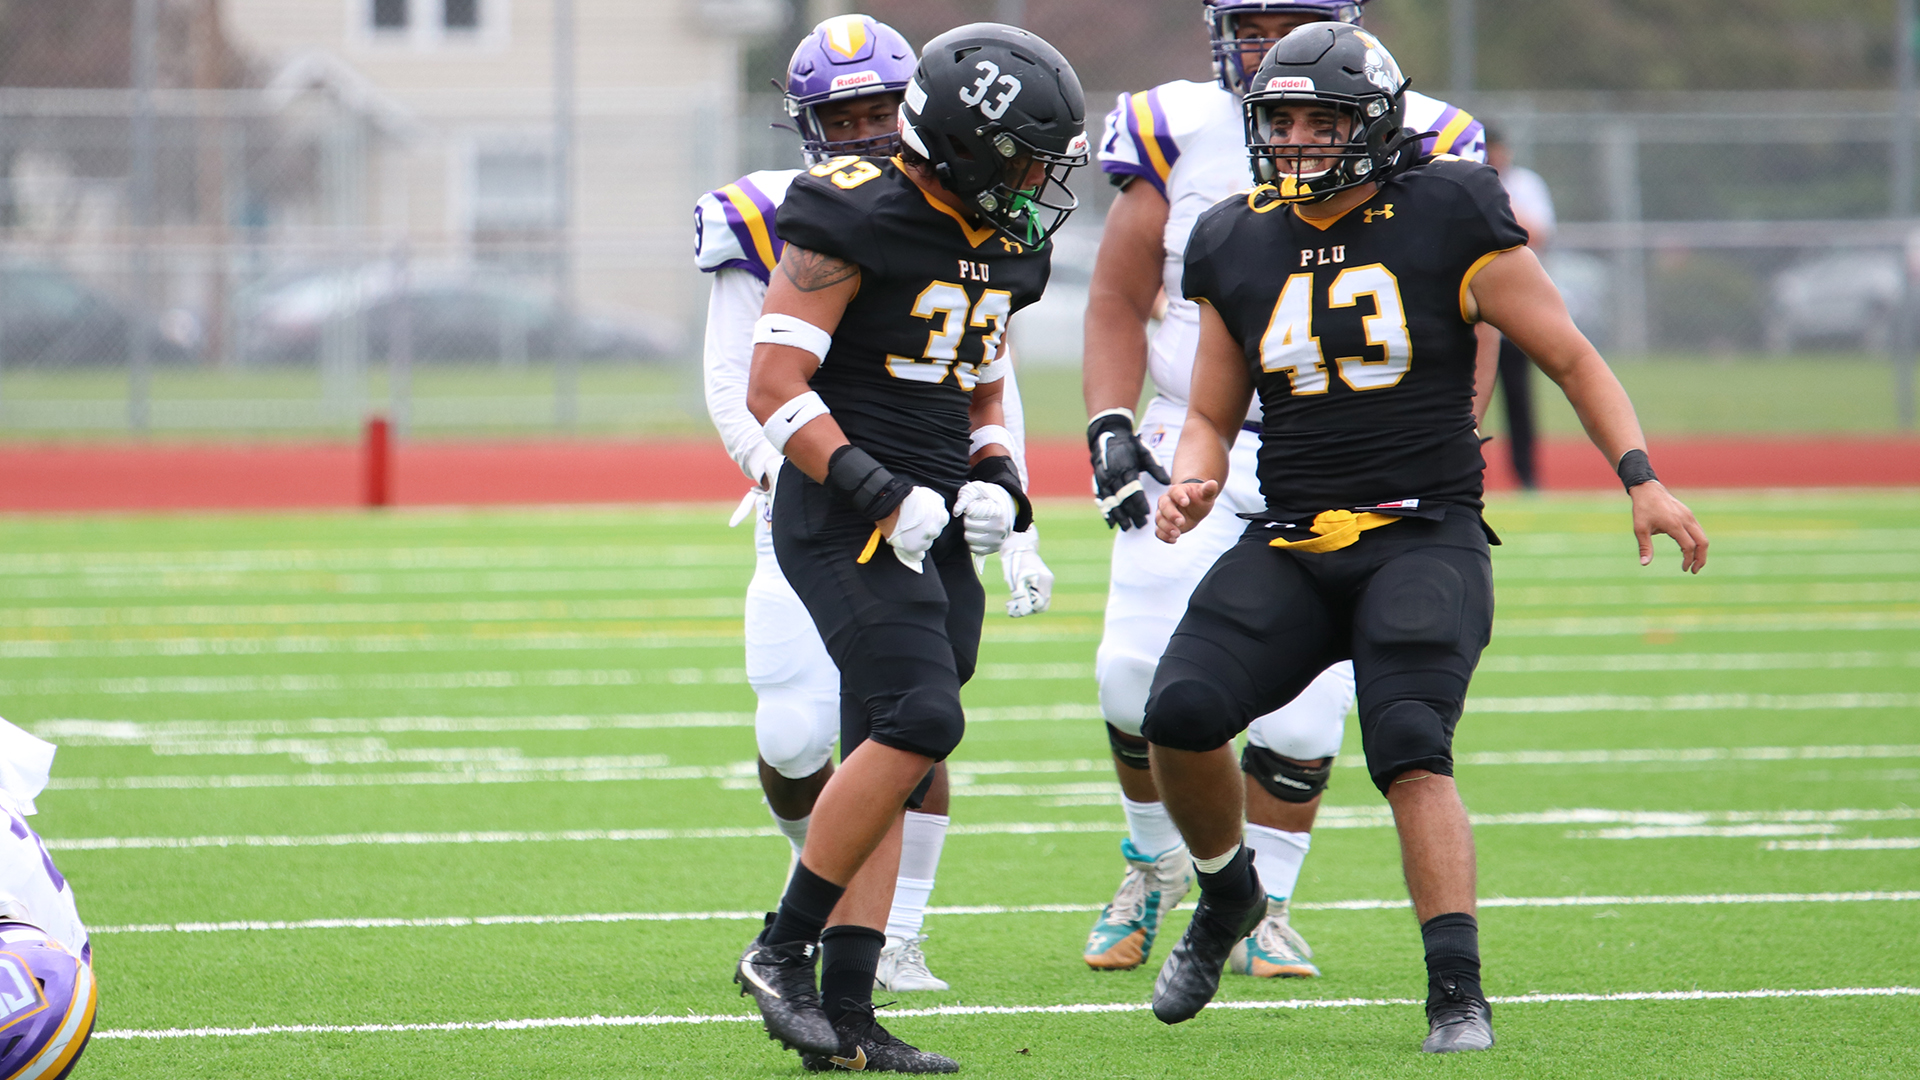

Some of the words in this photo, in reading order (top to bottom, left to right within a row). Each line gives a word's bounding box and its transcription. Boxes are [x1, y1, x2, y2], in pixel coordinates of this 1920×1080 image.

[836, 74, 874, 87] Riddell
[959, 60, 1022, 120] 33
[1271, 80, 1307, 88] Riddell
[809, 155, 882, 189] 33
[1300, 245, 1345, 266] PLU
[958, 259, 990, 282] PLU
[885, 280, 1012, 391] 33
[1259, 262, 1413, 396] 43
